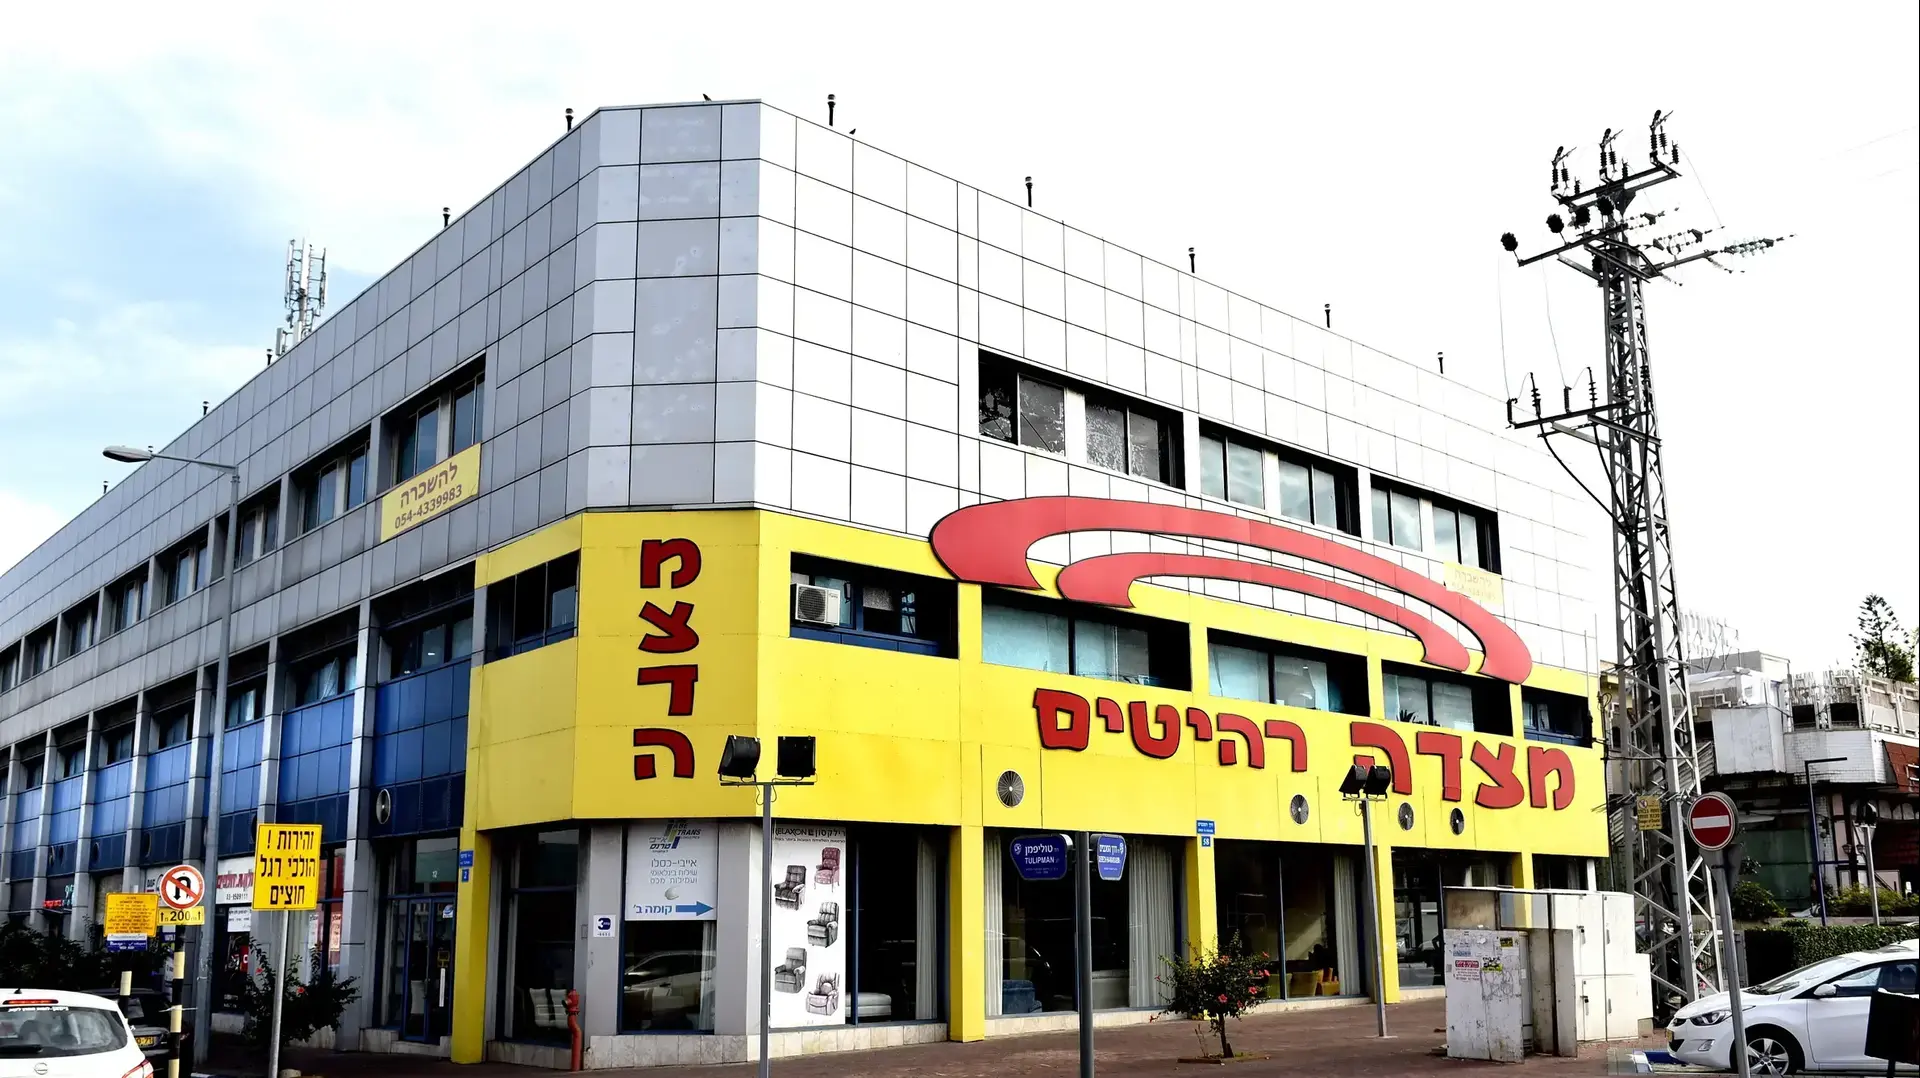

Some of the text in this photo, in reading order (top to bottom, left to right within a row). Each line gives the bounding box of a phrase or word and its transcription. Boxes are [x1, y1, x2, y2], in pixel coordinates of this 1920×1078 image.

[400, 462, 458, 508] להשכרה
[394, 484, 462, 529] 054-4339983
[632, 538, 702, 781] מצדה
[1033, 687, 1576, 811] מצדה רהיטים
[277, 830, 315, 850] זהירות
[1025, 843, 1053, 856] טוליפמן
[260, 853, 316, 878] הולכי רגל
[1025, 856, 1055, 865] TULIPMAN
[270, 885, 305, 905] חוצים
[170, 910, 191, 921] 200
[645, 905, 673, 915] קומה
